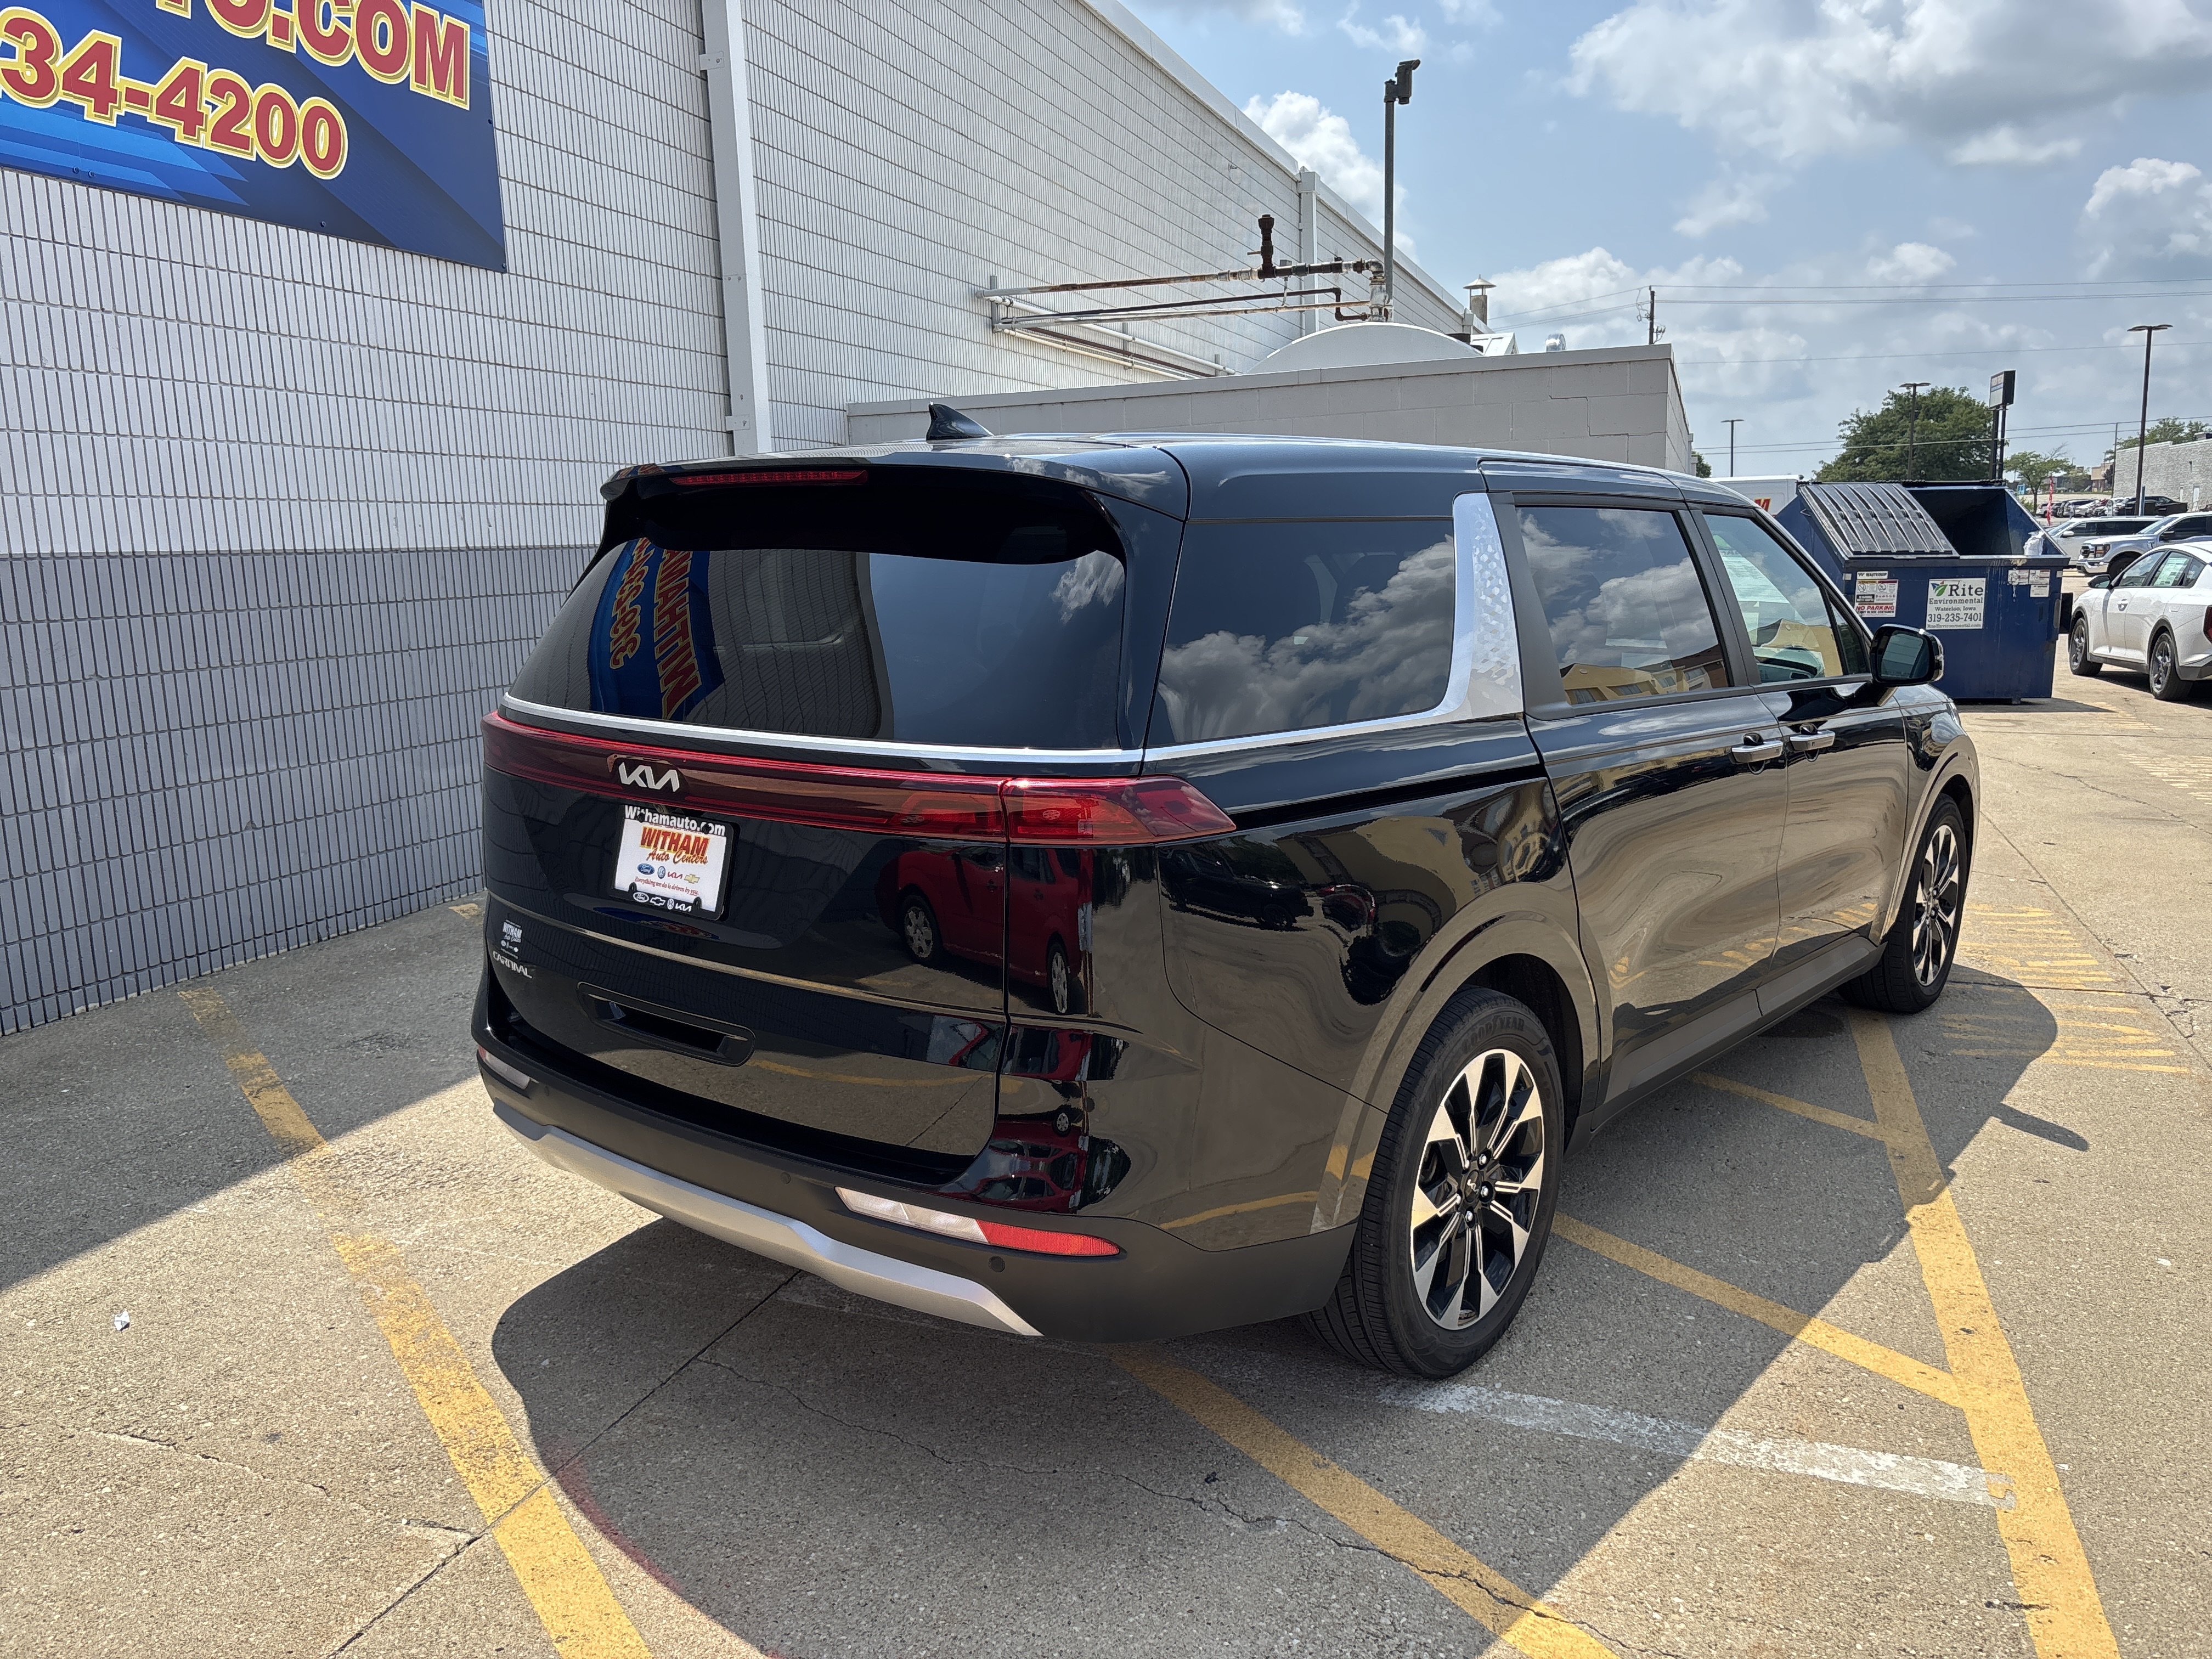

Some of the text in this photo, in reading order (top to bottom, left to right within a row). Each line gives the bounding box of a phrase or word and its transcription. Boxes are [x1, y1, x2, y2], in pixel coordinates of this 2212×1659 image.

[156, 0, 470, 110] .COM
[0, 5, 349, 179] 34-4200
[1948, 584, 1984, 596] Rite
[1927, 612, 1982, 623] 319-235-7401
[618, 761, 680, 792] KIA
[624, 804, 725, 836] Wihamauto.com
[639, 825, 711, 856] WITHAM
[646, 848, 708, 865] Auto Centers
[634, 876, 656, 888] Everything
[672, 884, 685, 893] driven
